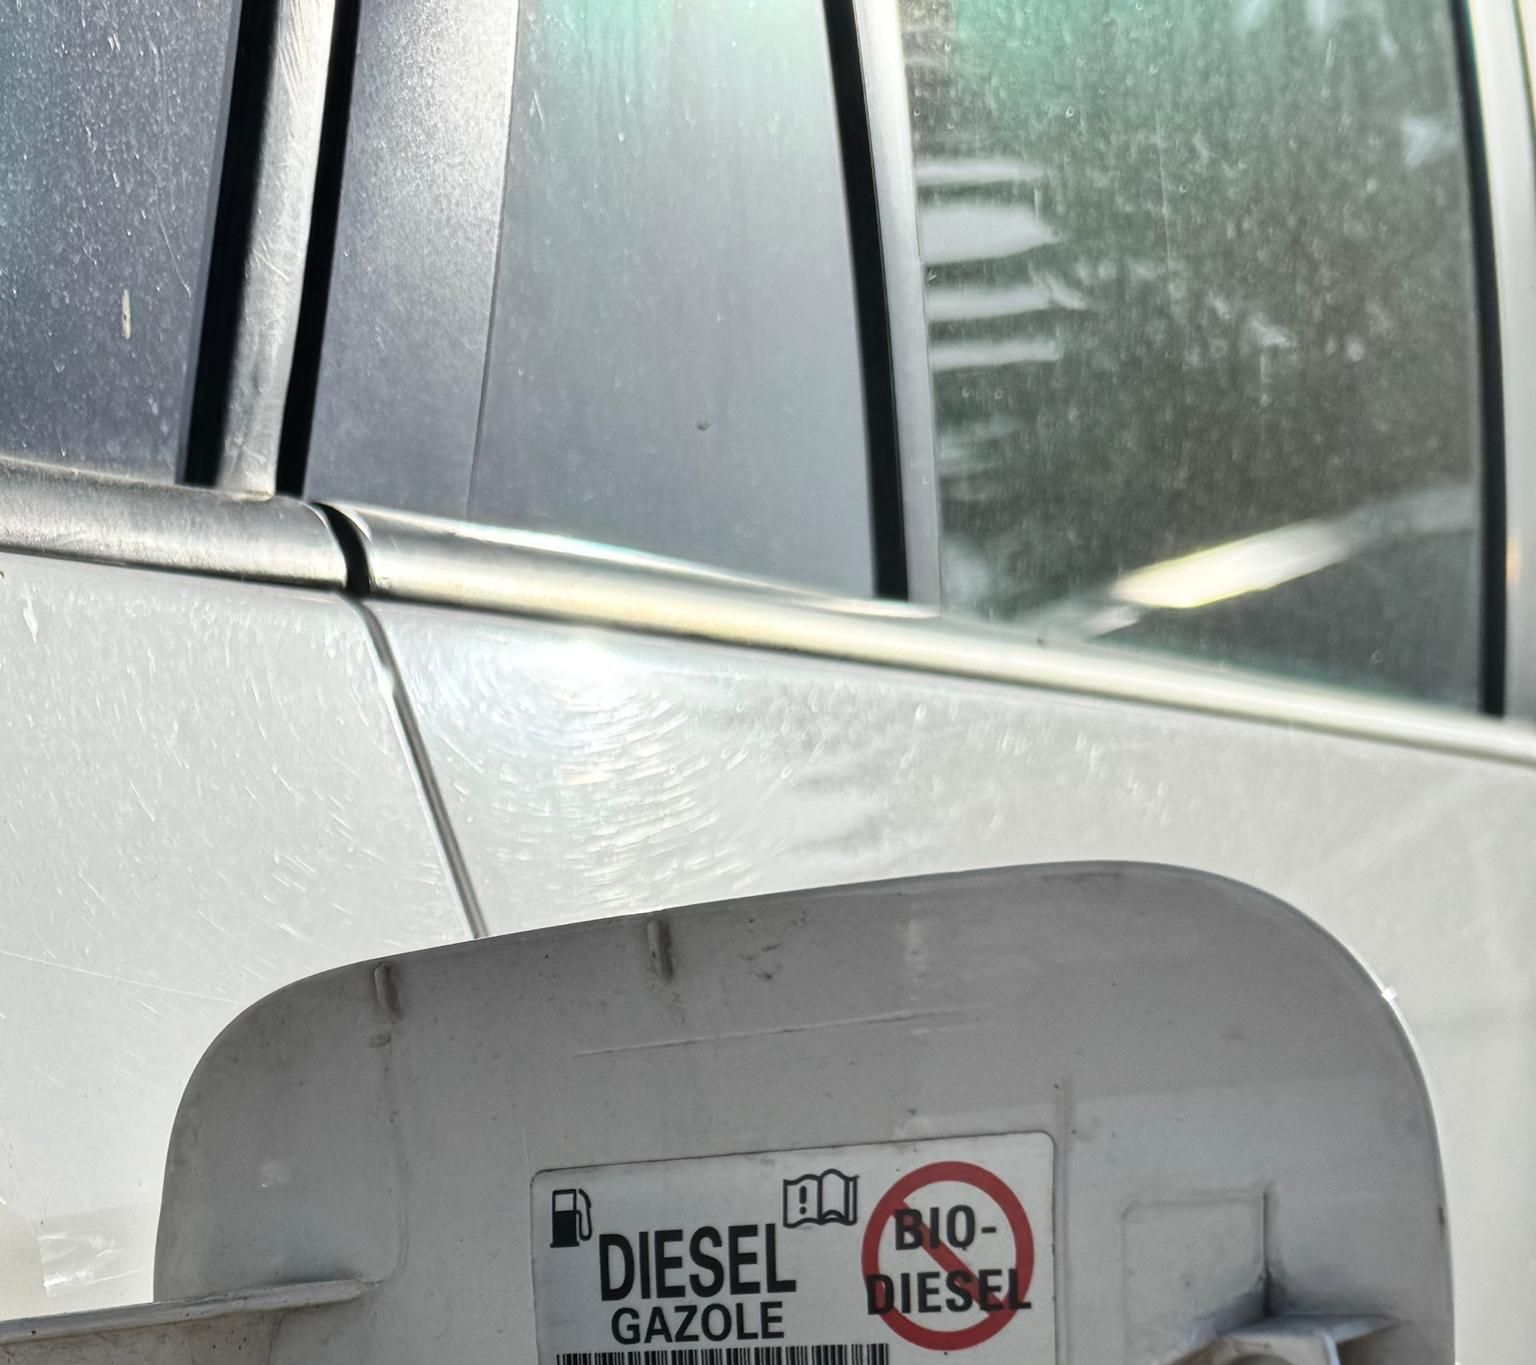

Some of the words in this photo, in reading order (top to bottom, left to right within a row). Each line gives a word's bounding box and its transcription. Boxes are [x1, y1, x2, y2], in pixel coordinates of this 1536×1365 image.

[893, 1204, 997, 1251] BIO-
[598, 1223, 797, 1302] DIESEL
[865, 1267, 1032, 1316] DIESEL
[611, 1301, 785, 1344] GAZOLE
